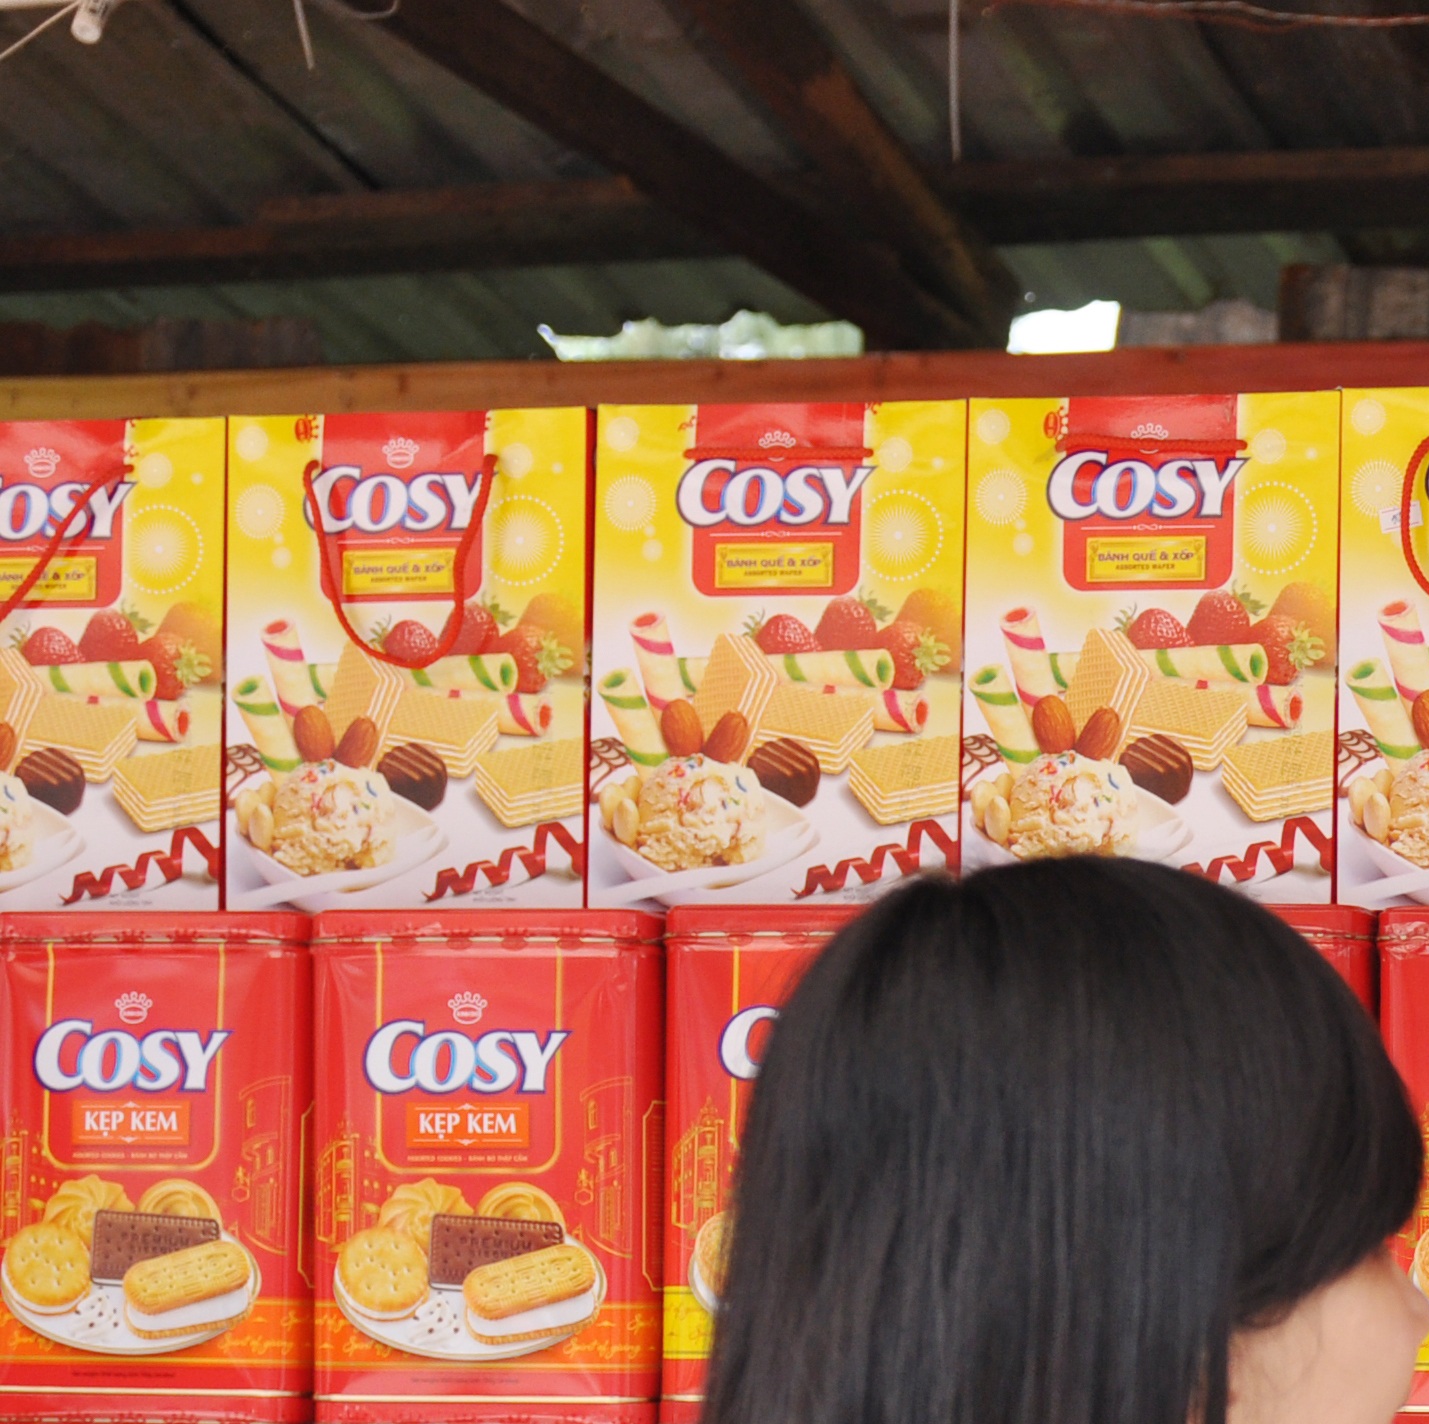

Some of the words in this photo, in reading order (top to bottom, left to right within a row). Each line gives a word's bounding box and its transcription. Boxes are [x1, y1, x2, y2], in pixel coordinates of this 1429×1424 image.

[0, 478, 138, 543] OSY
[303, 464, 498, 534] COSY
[676, 458, 878, 527] COSY
[1046, 449, 1250, 520] COSY
[33, 1018, 234, 1094] COSY
[363, 1017, 573, 1096] COSY
[84, 1110, 124, 1137] KẸP
[130, 1110, 178, 1132] KEM
[418, 1112, 461, 1140] KẸP
[467, 1112, 517, 1134] KEM
